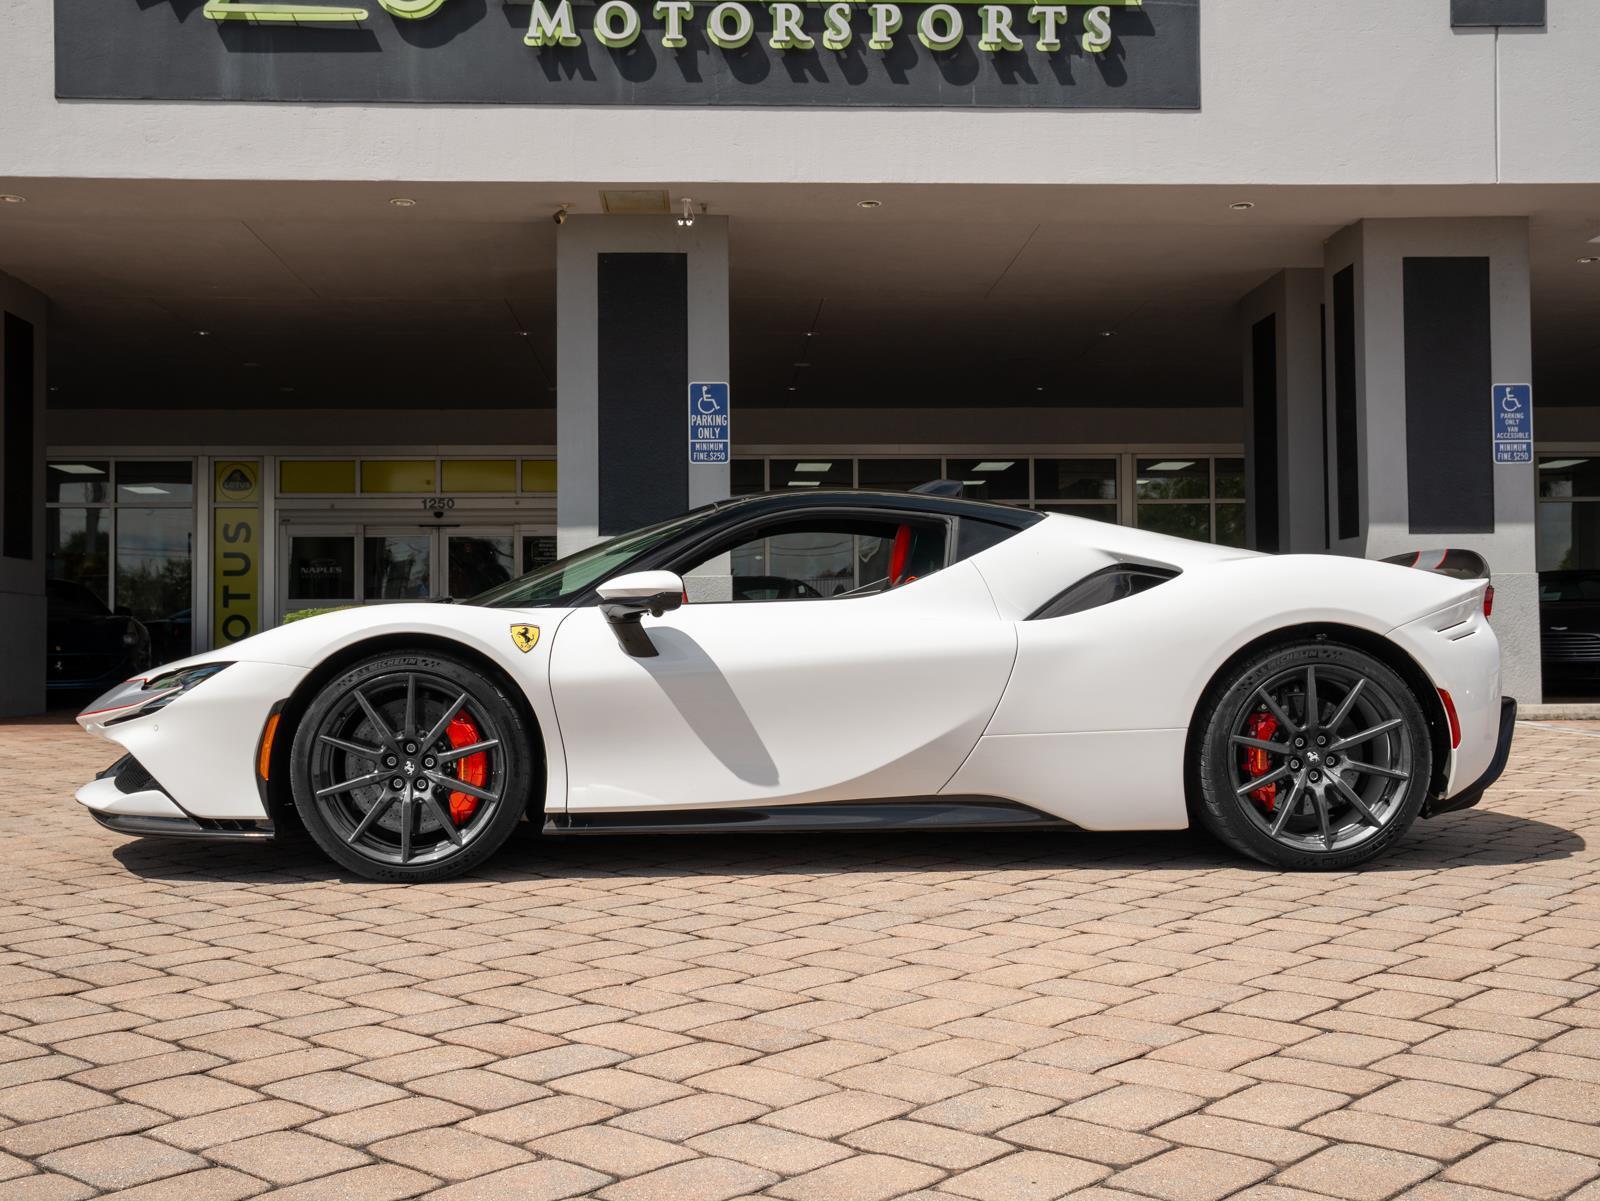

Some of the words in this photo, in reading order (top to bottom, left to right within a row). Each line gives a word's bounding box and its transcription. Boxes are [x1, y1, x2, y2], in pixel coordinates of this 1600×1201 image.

[525, 0, 1113, 50] MOTORSPORTS
[691, 414, 727, 426] PARKING
[698, 427, 720, 439] ONLY
[695, 442, 724, 451] MINIMUM
[1499, 443, 1527, 452] MINIMUM
[693, 452, 707, 461] FINE
[709, 452, 726, 461] $250
[1497, 452, 1511, 461] FINE
[1513, 452, 1529, 461] $250
[421, 497, 455, 509] 1250
[300, 566, 343, 574] NAPLES
[222, 521, 252, 642] OTUS
